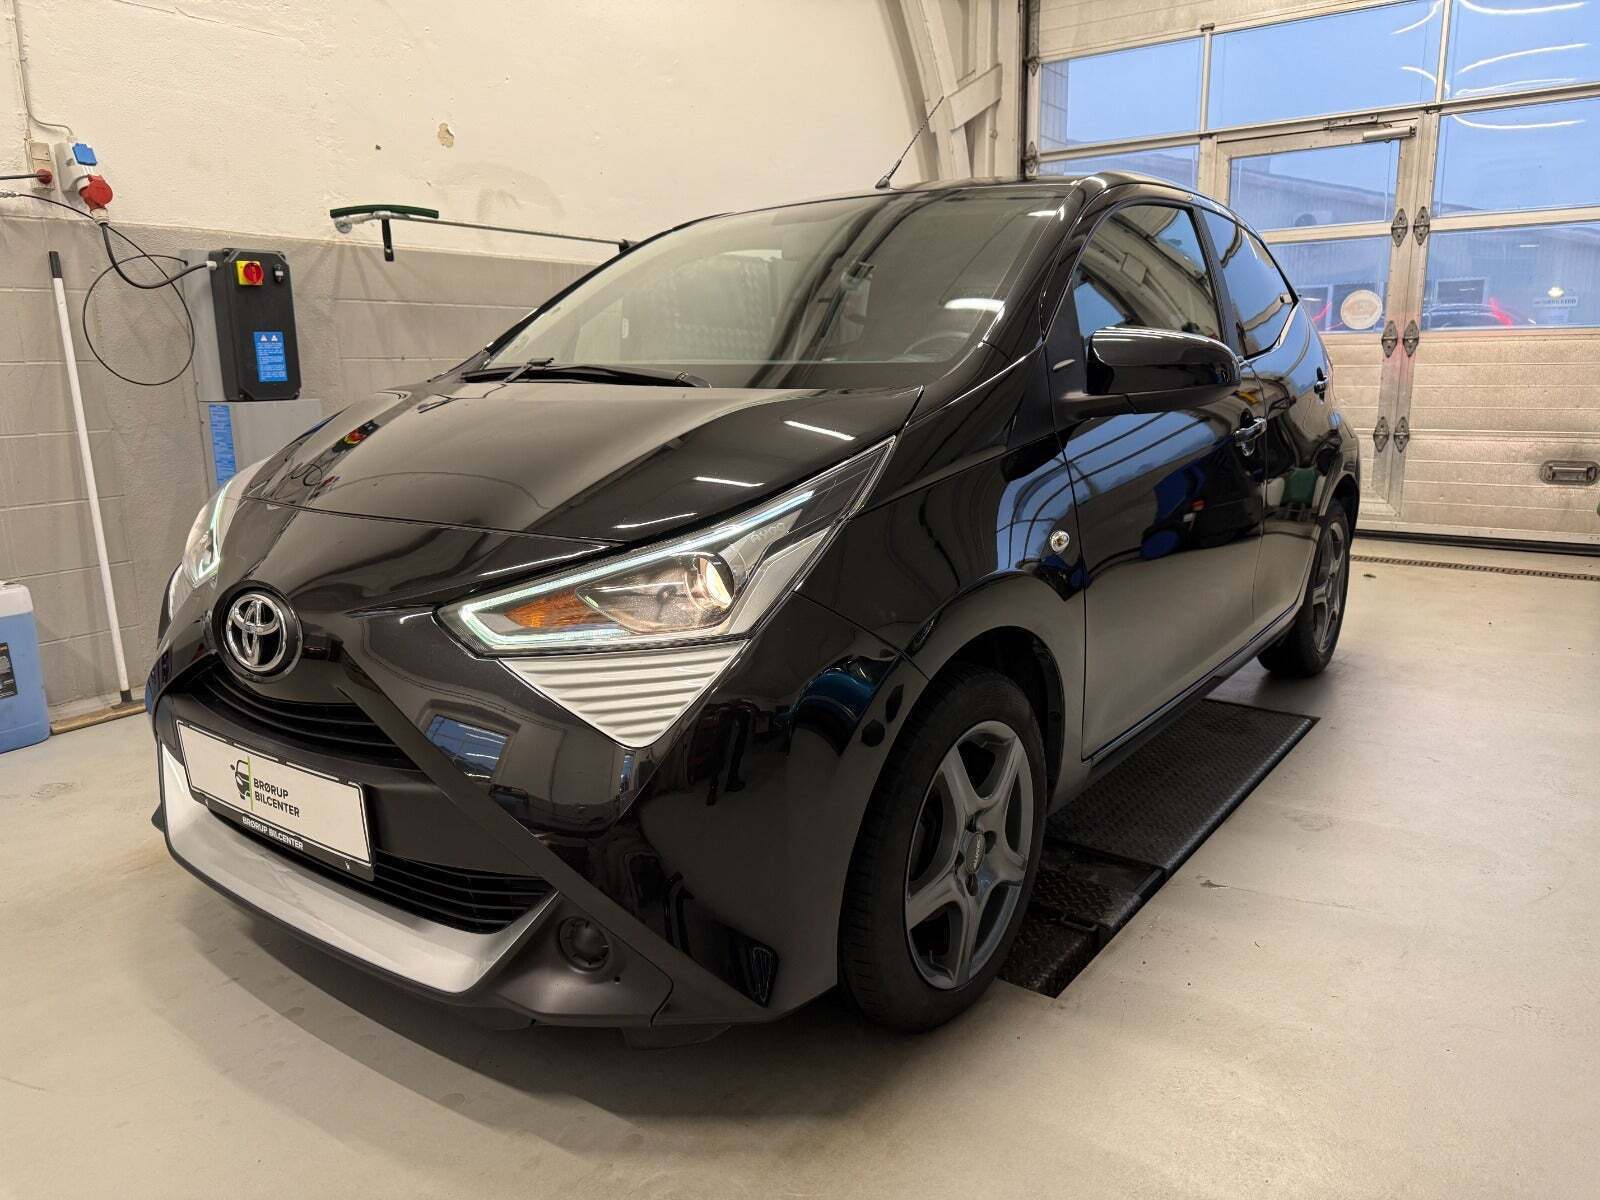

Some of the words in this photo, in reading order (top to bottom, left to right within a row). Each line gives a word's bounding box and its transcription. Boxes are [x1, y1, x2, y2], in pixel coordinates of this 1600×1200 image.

[253, 778, 289, 799] BRØRUP
[254, 791, 300, 818] BILCENTER
[242, 816, 268, 834] BRØRUP
[268, 828, 304, 851] BILCENTER
